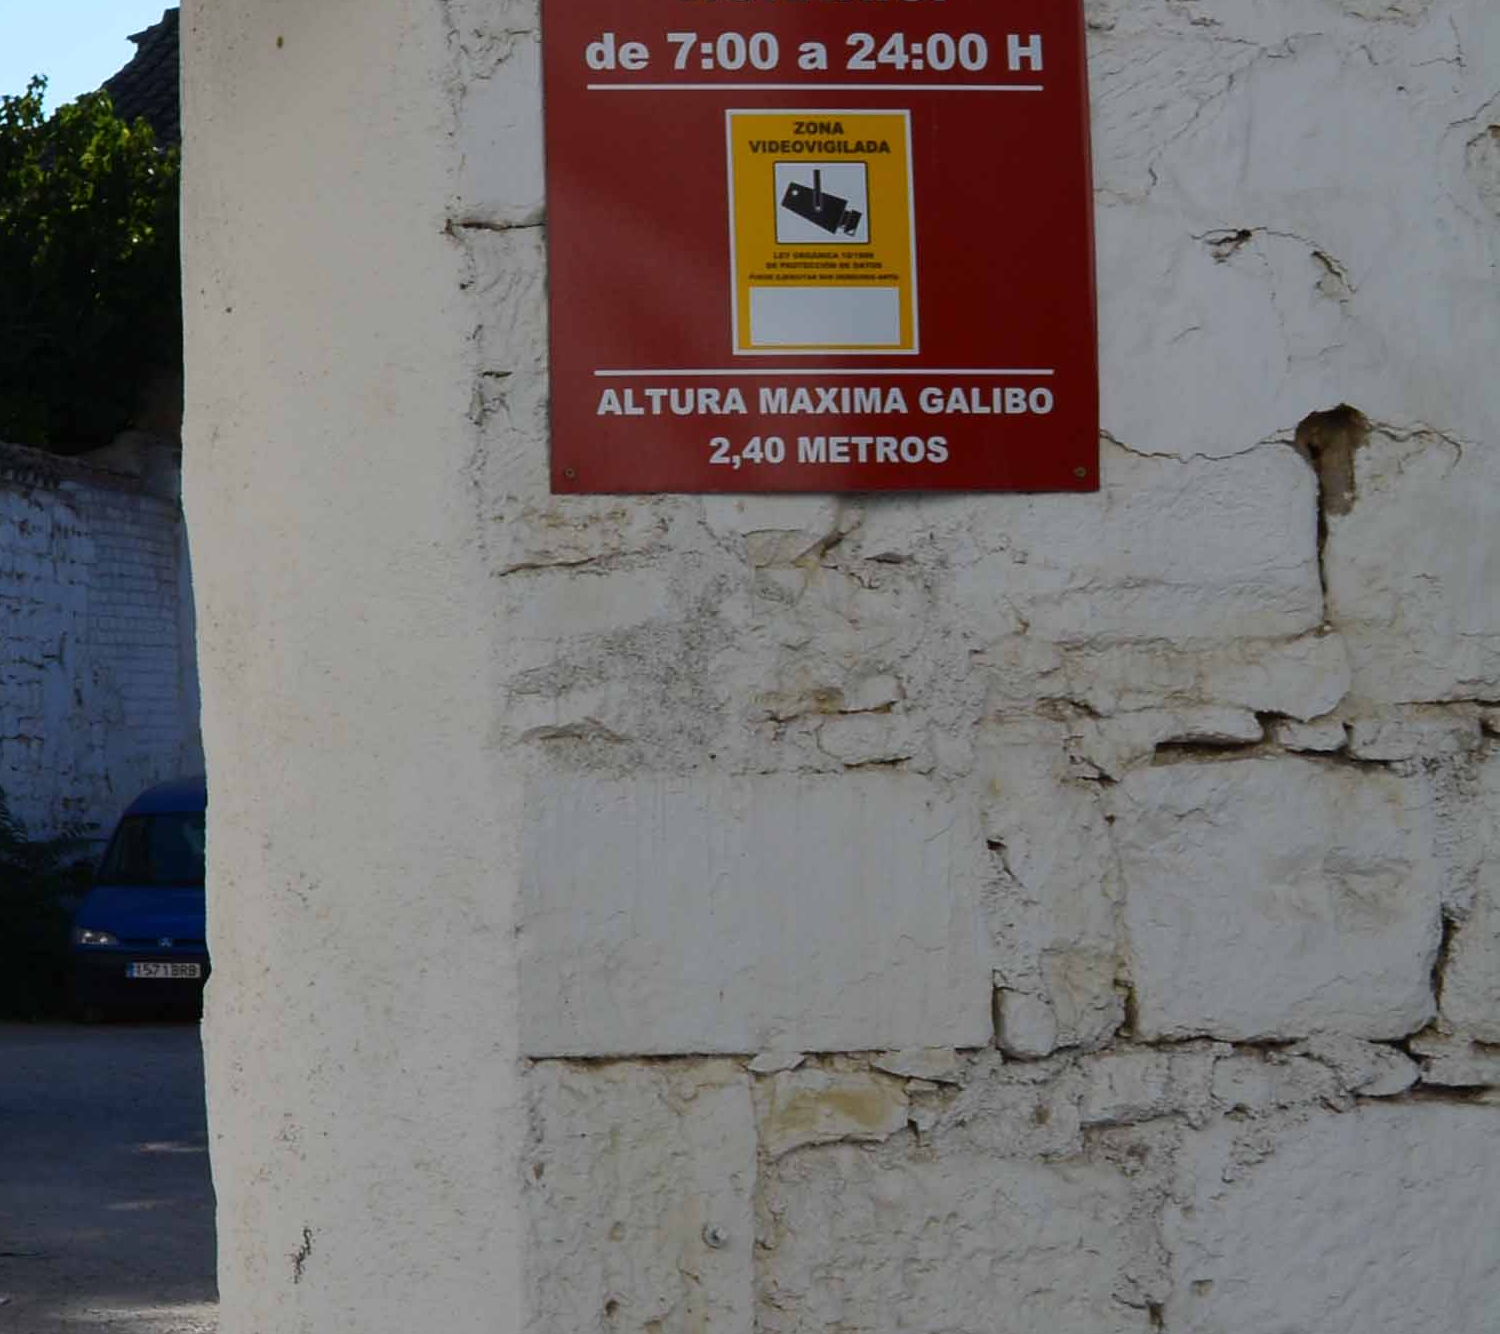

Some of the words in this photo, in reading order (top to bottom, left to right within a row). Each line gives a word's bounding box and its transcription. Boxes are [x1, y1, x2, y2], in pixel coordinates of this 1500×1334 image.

[586, 33, 649, 69] de
[667, 32, 778, 70] 7:00
[798, 43, 827, 69] a
[846, 33, 987, 70] 24:00
[1008, 35, 1042, 70] H
[794, 122, 844, 134] ZONA
[749, 140, 890, 153] VIDEOVIGILADA
[597, 388, 747, 415] ALTURA
[759, 387, 908, 414] MAXIMA
[919, 387, 1053, 414] GALIBO
[710, 437, 785, 469] 2,40
[798, 437, 948, 463] METROS
